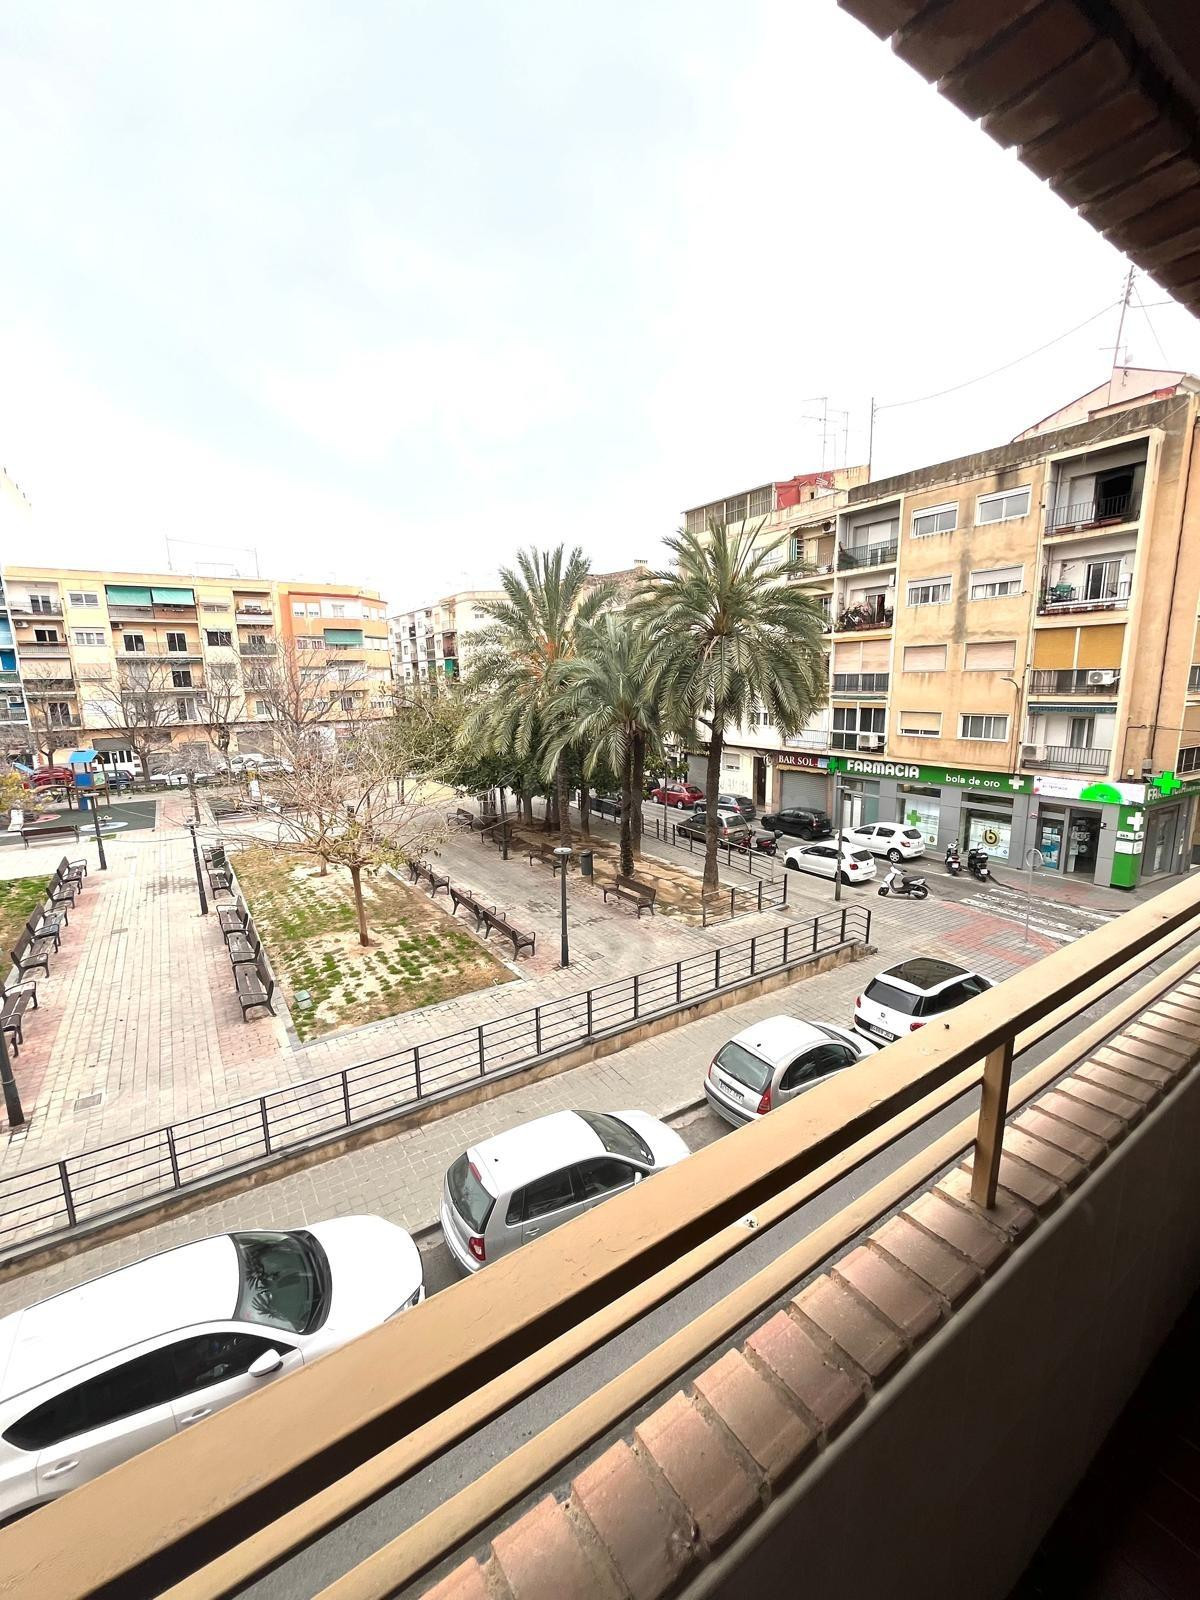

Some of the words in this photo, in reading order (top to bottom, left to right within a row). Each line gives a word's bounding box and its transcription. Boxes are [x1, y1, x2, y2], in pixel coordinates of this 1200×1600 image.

[778, 755, 795, 765] BAR
[797, 757, 815, 767] SOL
[847, 759, 920, 779] FARMACIA
[945, 773, 966, 784] bola
[968, 776, 981, 786] de
[983, 779, 1000, 788] oro
